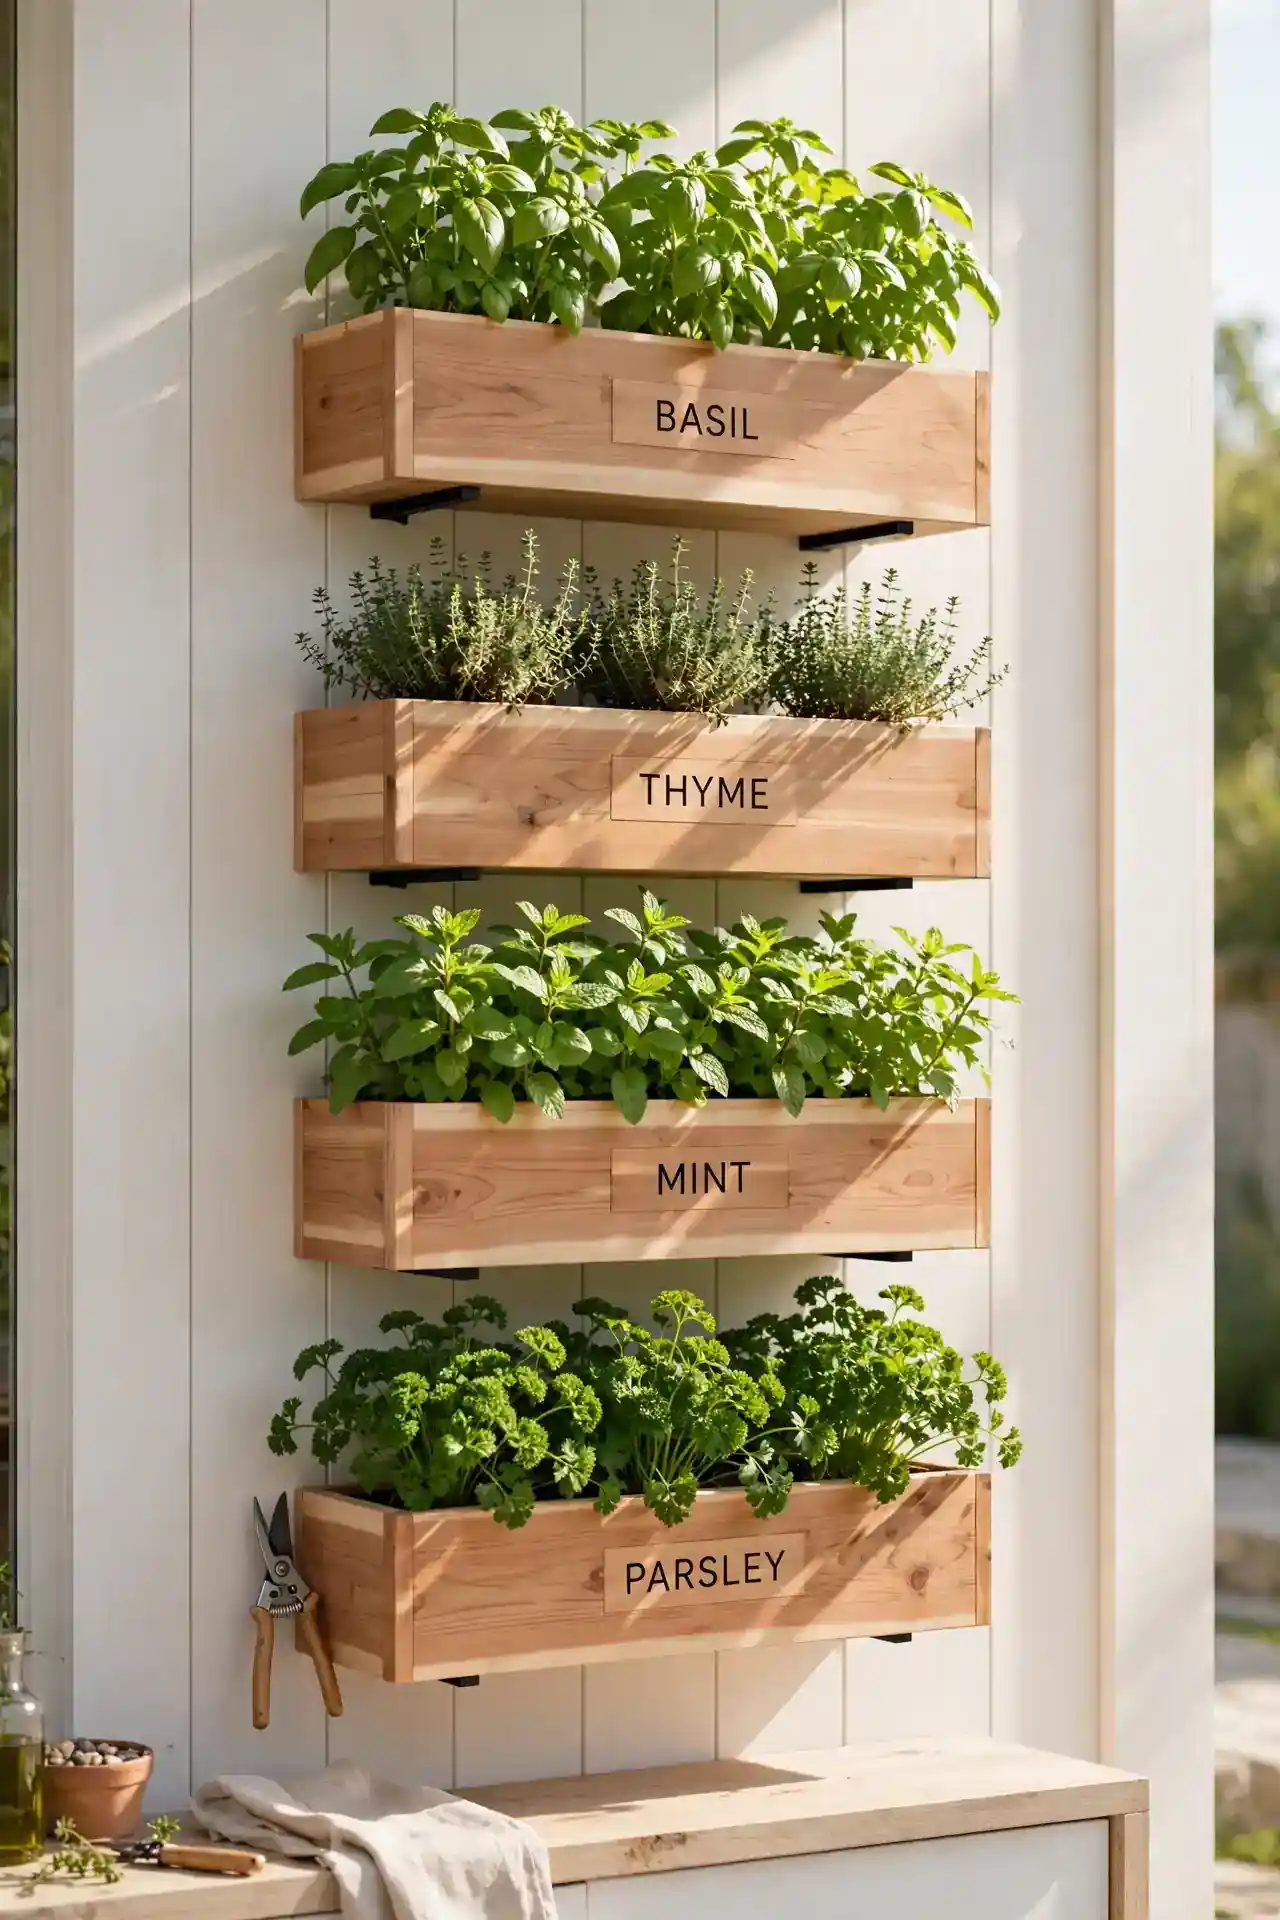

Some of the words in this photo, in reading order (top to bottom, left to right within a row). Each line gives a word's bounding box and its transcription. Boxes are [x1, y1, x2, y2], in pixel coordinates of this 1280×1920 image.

[656, 399, 759, 440] BASIL
[639, 773, 769, 810] THYME
[658, 1161, 750, 1196] MINT
[626, 1549, 785, 1595] PARSLEY
